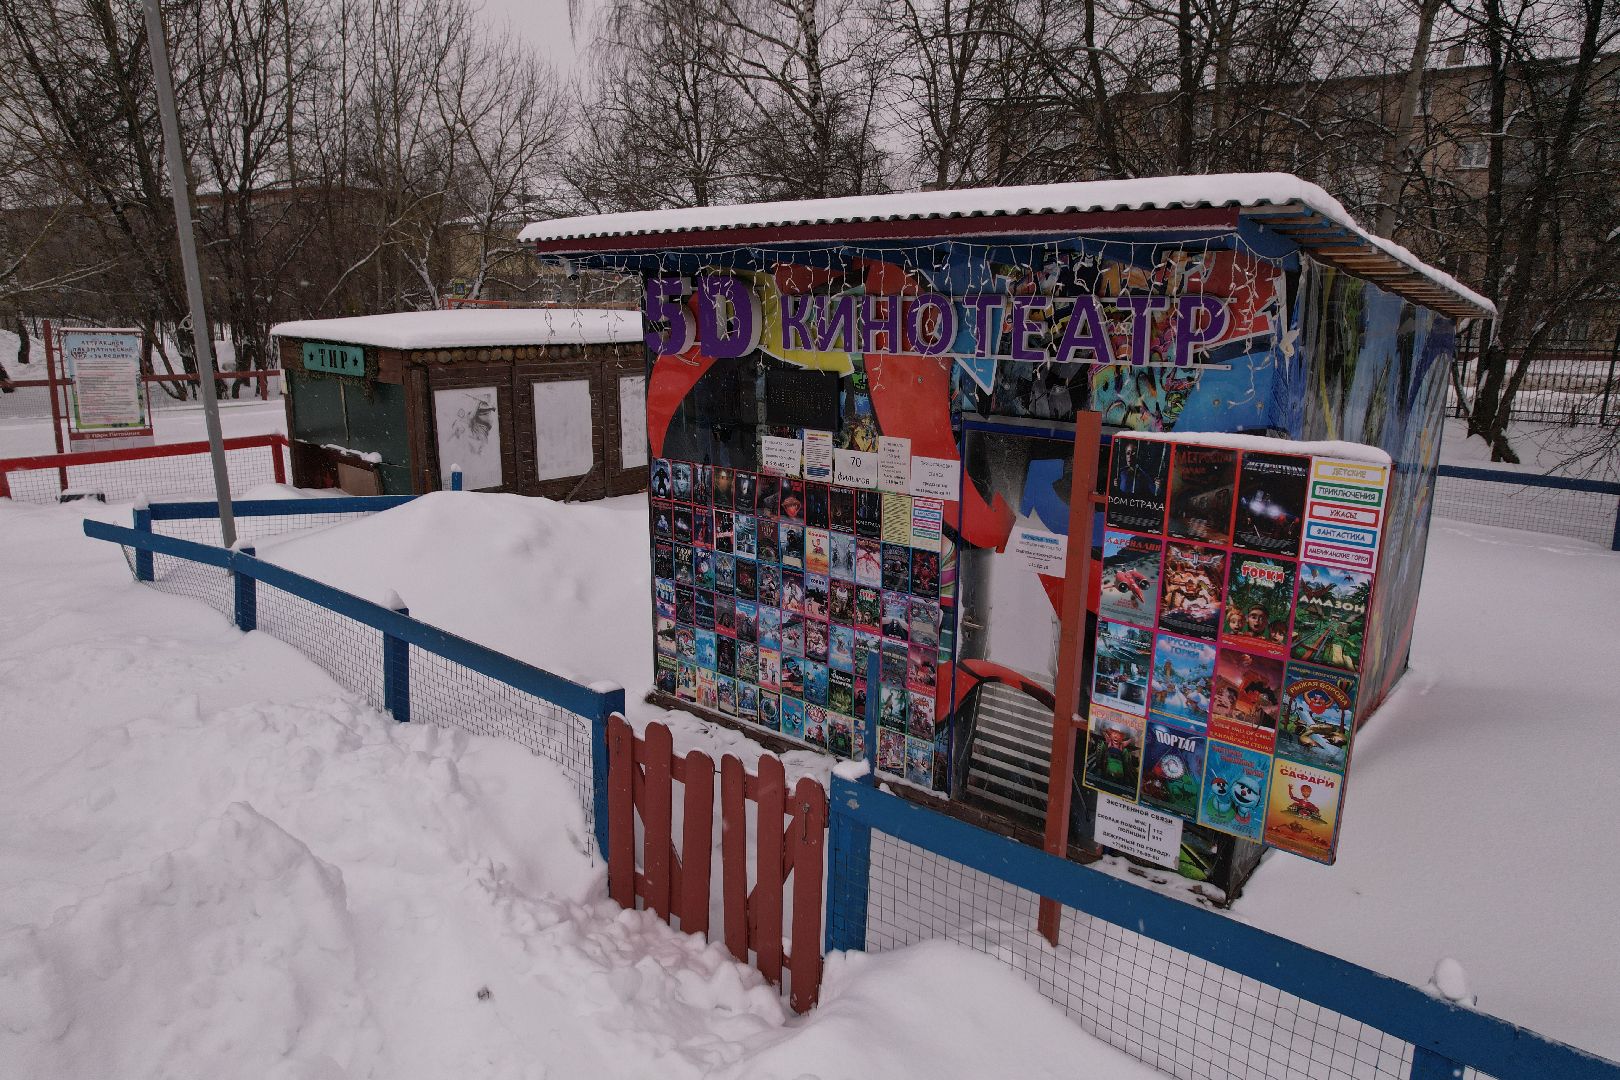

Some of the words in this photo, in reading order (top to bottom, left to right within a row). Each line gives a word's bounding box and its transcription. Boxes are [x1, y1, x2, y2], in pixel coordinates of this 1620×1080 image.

[645, 273, 762, 359] 5D
[780, 293, 1232, 367] КИНОТЕАТР
[318, 348, 348, 370] ТИР
[850, 456, 862, 468] 70
[1331, 467, 1367, 479] ДЕТСКИЕ
[1318, 486, 1376, 501] ПРИКЛЮЧЕНИЯ
[1107, 495, 1128, 507] ДОМ
[1129, 498, 1165, 512] СТРАХА
[1329, 509, 1358, 520] УЖАСЫ
[1316, 527, 1366, 542] ФАНТАСТИКА
[1308, 547, 1350, 560] АМЕРИКАНСКИЕ
[1351, 553, 1369, 563] ГОРКИ
[1241, 564, 1285, 583] ГОРКИ
[1299, 594, 1366, 614] АМАЗОН
[1289, 681, 1319, 694] РЫЖАЯ
[1319, 682, 1348, 706] БОРОДА
[1154, 729, 1197, 754] ПОРТАЛ
[1279, 767, 1336, 789] САФАРИ
[1106, 798, 1149, 817] ЭКСТРЕННОЙ
[1150, 813, 1173, 825] СВЯЗИ
[1097, 813, 1119, 824] СКОРАЯ
[1120, 821, 1147, 833] ПОМОЩЬ
[1117, 826, 1146, 840] ПОЛИЦИЯ
